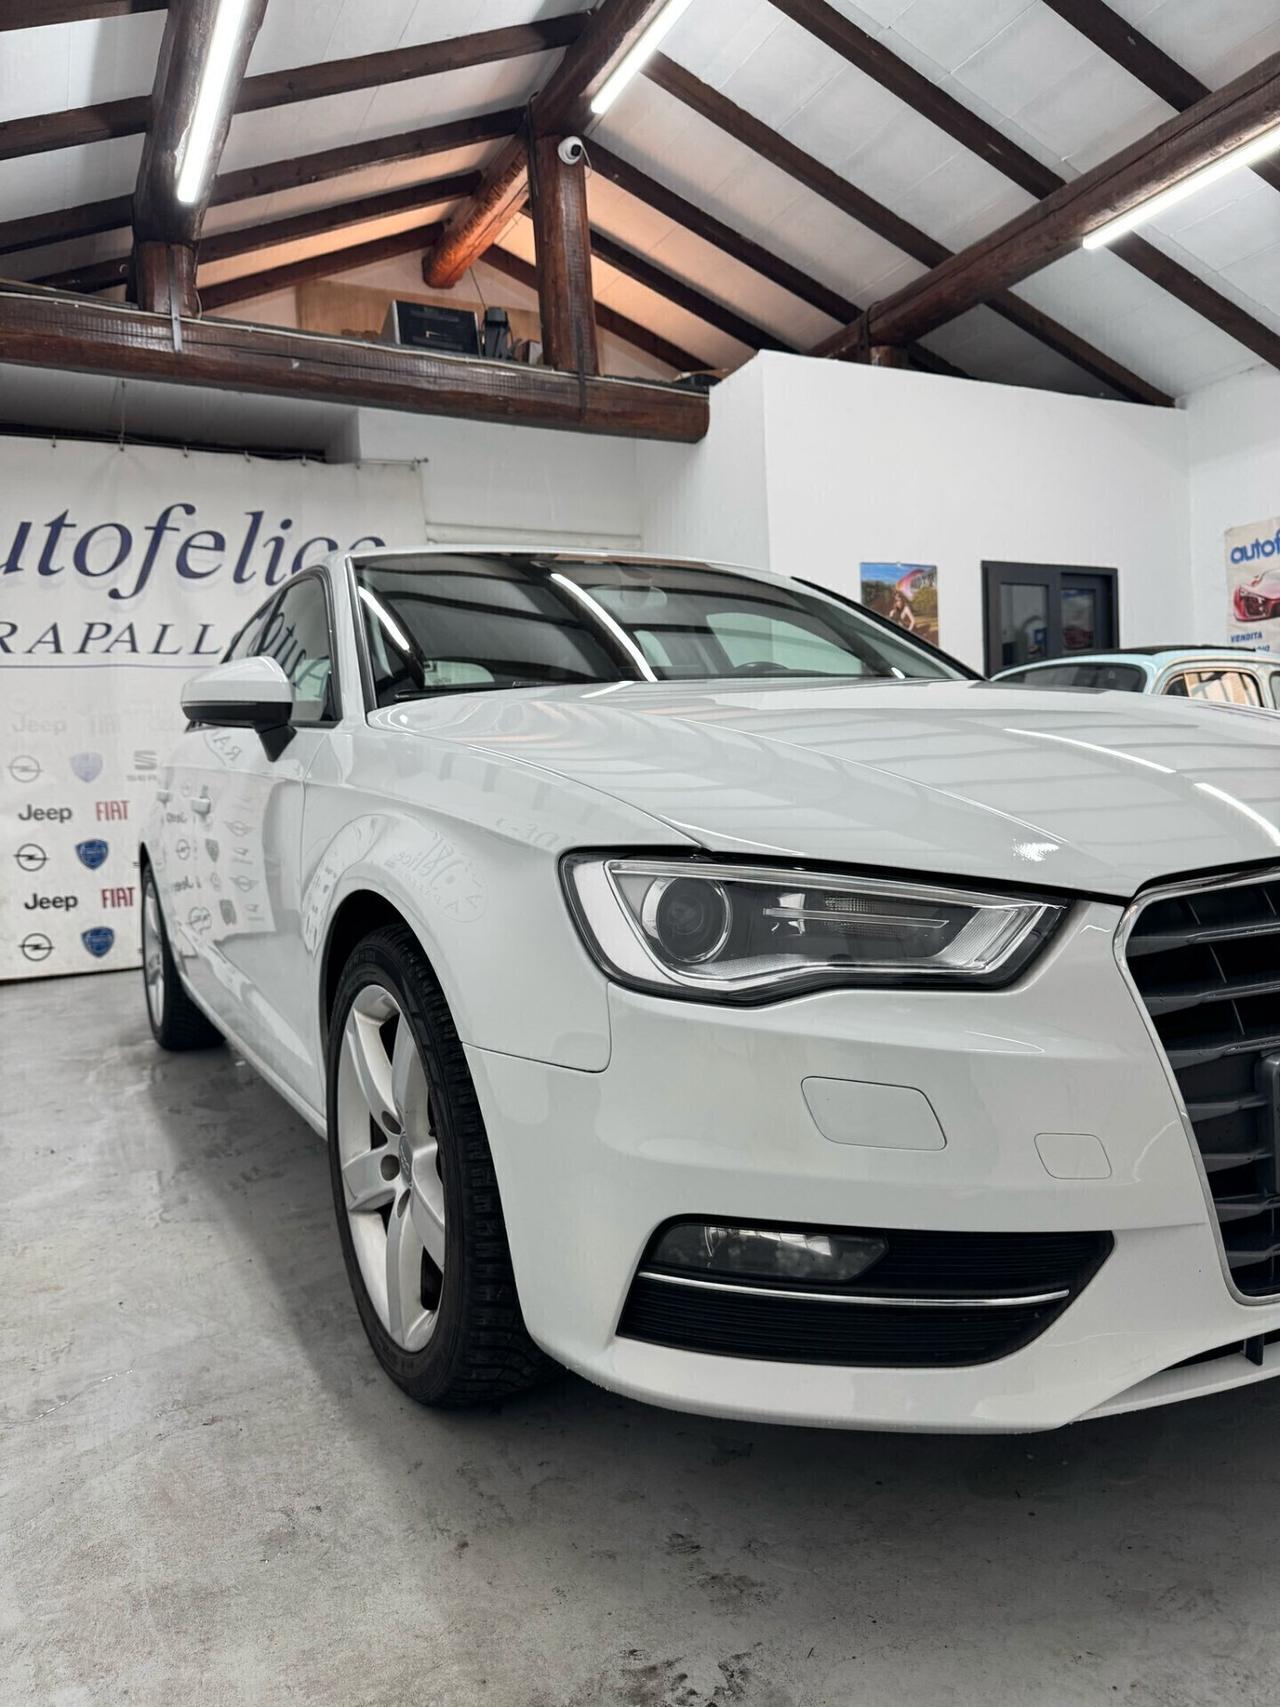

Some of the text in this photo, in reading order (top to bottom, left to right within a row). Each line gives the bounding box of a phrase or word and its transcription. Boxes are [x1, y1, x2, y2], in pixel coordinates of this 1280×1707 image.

[0, 620, 240, 656] RAPALL
[1231, 631, 1263, 643] VENDITA
[18, 800, 130, 823] Jeep FIAT
[24, 886, 136, 911] Jeep FIAT
